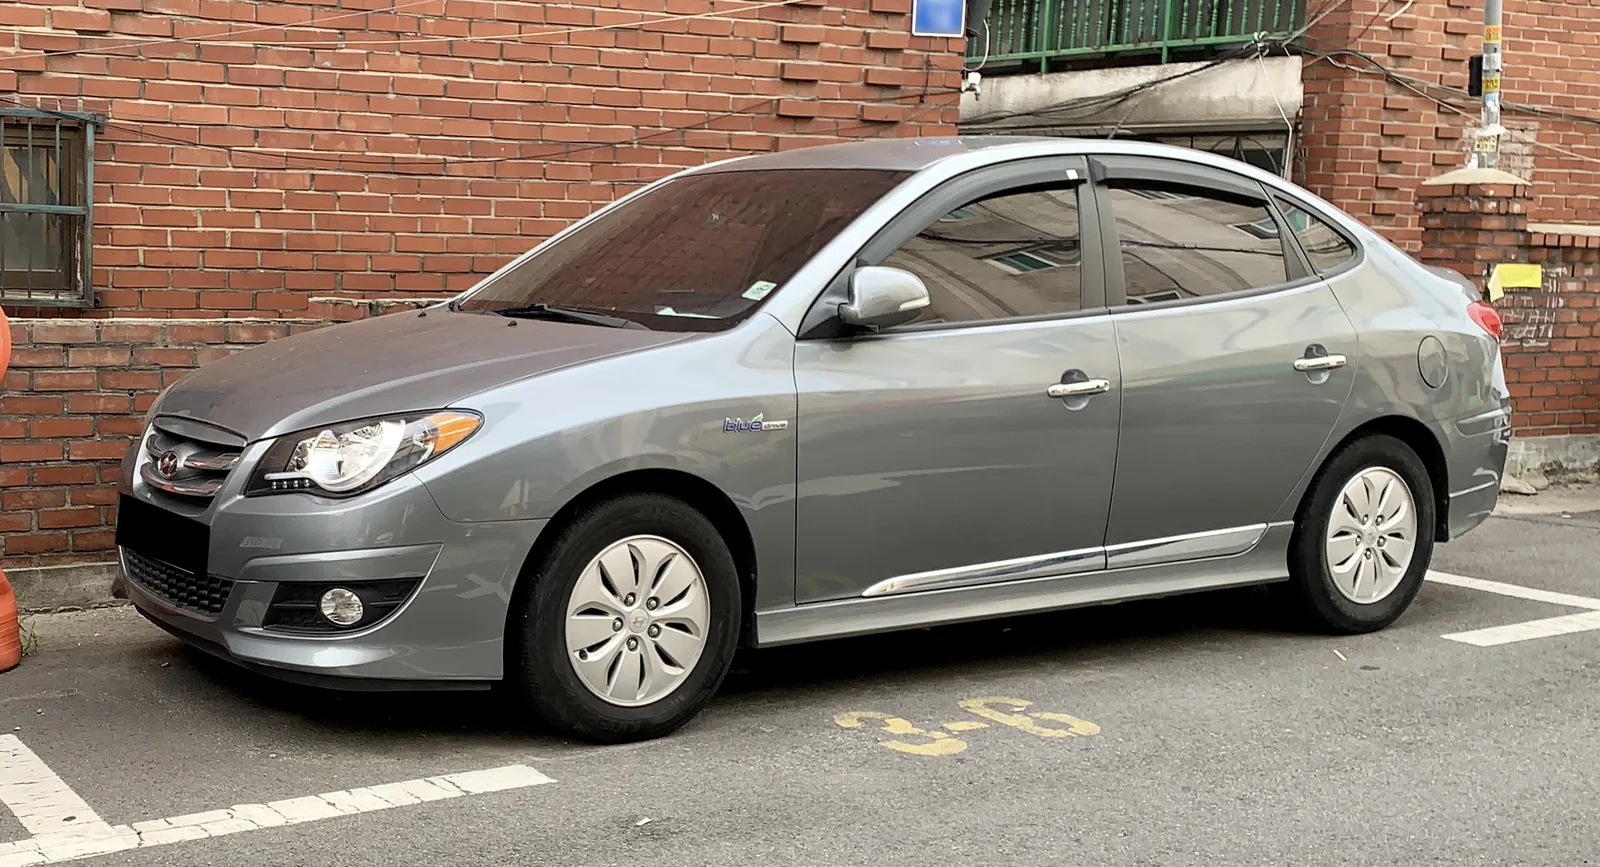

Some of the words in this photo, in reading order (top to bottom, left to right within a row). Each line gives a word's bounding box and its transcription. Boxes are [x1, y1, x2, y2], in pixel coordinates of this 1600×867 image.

[723, 416, 763, 433] blue
[763, 421, 787, 430] drive
[833, 697, 1101, 757] 3-6
